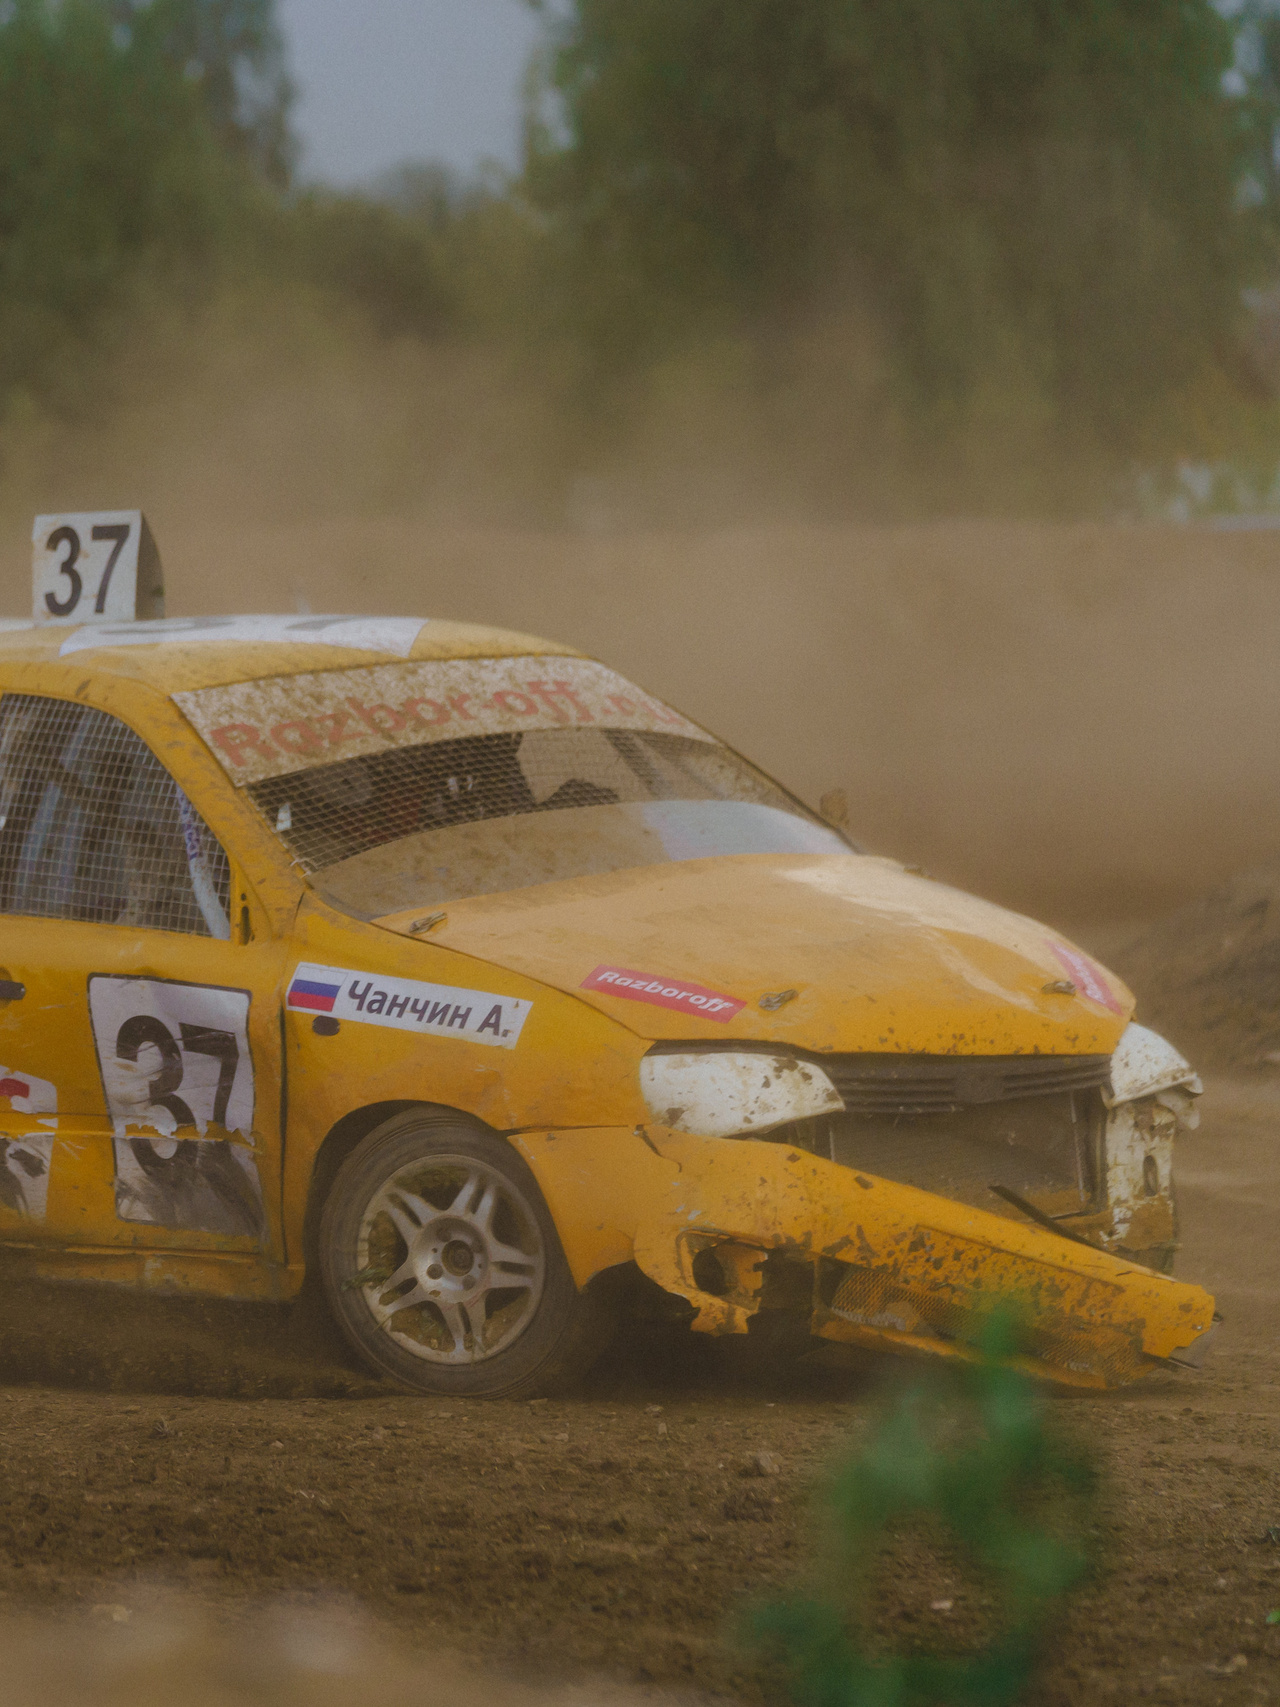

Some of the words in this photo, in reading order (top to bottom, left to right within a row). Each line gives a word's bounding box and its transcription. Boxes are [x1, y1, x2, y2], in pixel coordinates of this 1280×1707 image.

[45, 524, 130, 616] 37
[347, 979, 473, 1030] Чанчин
[477, 1003, 515, 1039] А.
[596, 970, 735, 1013] Razboroff
[116, 1014, 240, 1177] 37
